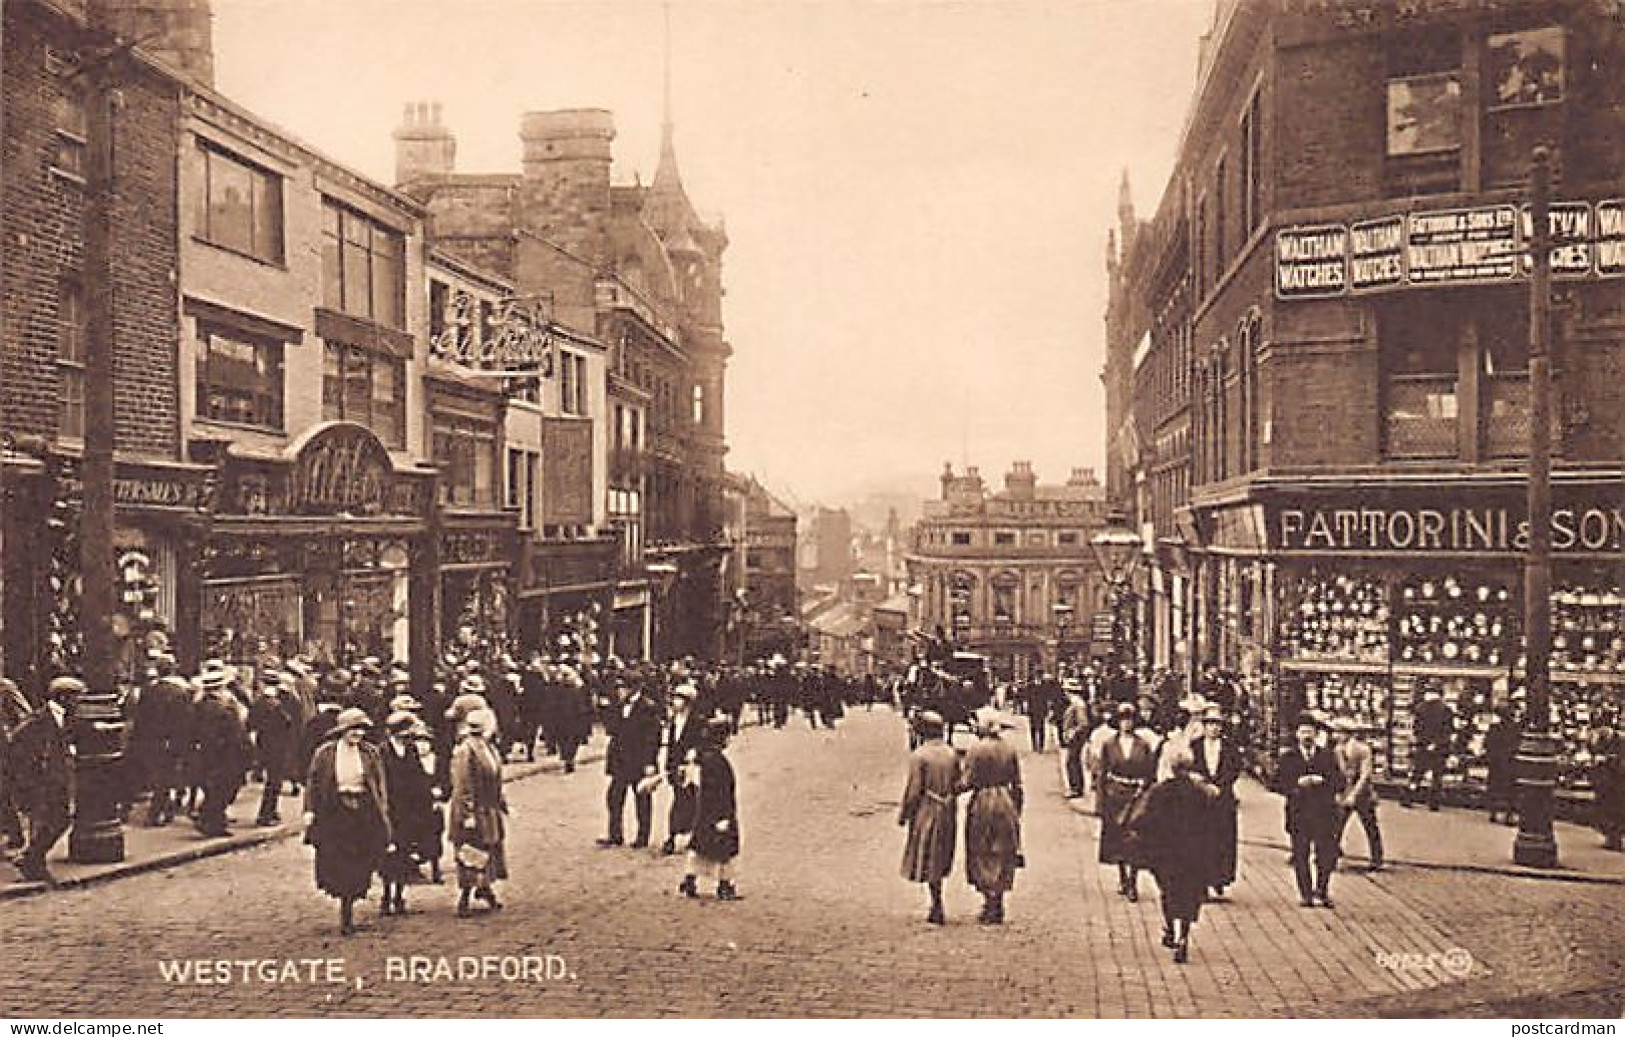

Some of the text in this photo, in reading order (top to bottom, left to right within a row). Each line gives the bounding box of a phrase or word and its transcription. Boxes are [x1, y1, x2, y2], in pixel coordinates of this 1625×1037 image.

[1280, 233, 1343, 260] WALTHAM
[1280, 263, 1343, 288] WATCHES
[1281, 510, 1508, 549] FATTORINI
